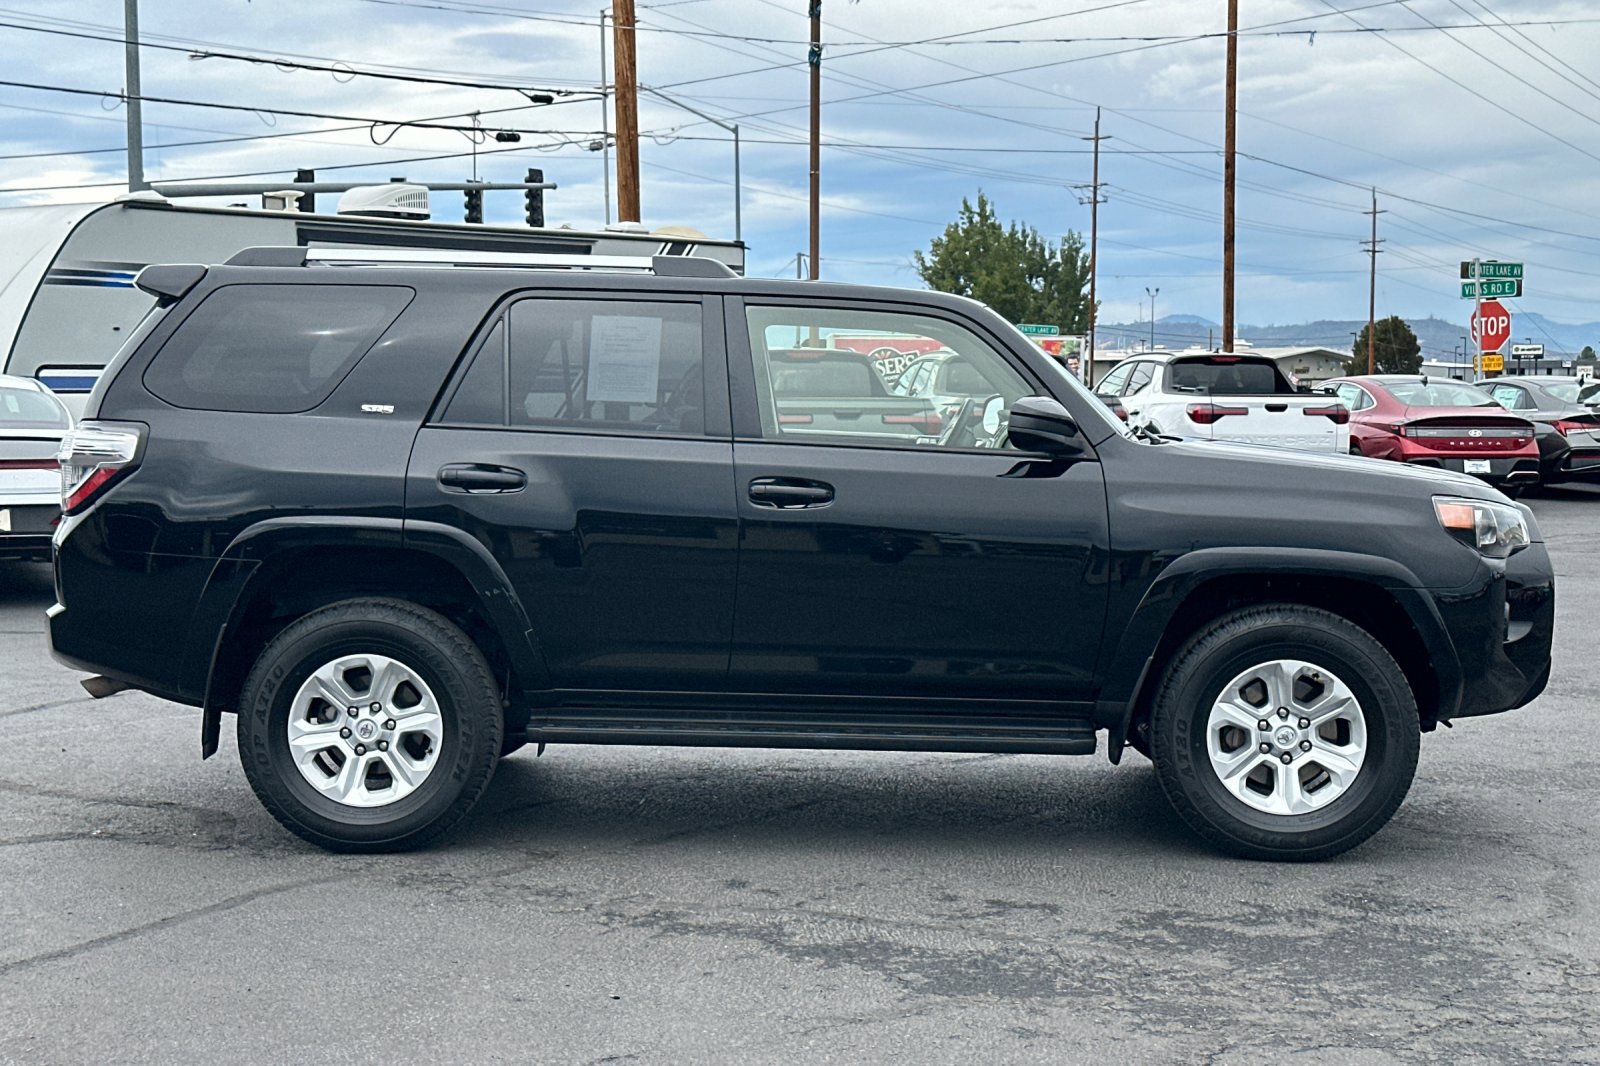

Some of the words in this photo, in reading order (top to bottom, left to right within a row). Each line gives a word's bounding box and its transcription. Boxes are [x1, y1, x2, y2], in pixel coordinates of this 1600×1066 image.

[1470, 264, 1494, 276] CTER
[1495, 265, 1511, 276] LAKE
[1490, 283, 1503, 294] RD
[1505, 282, 1511, 293] E
[1473, 316, 1508, 336] STOP
